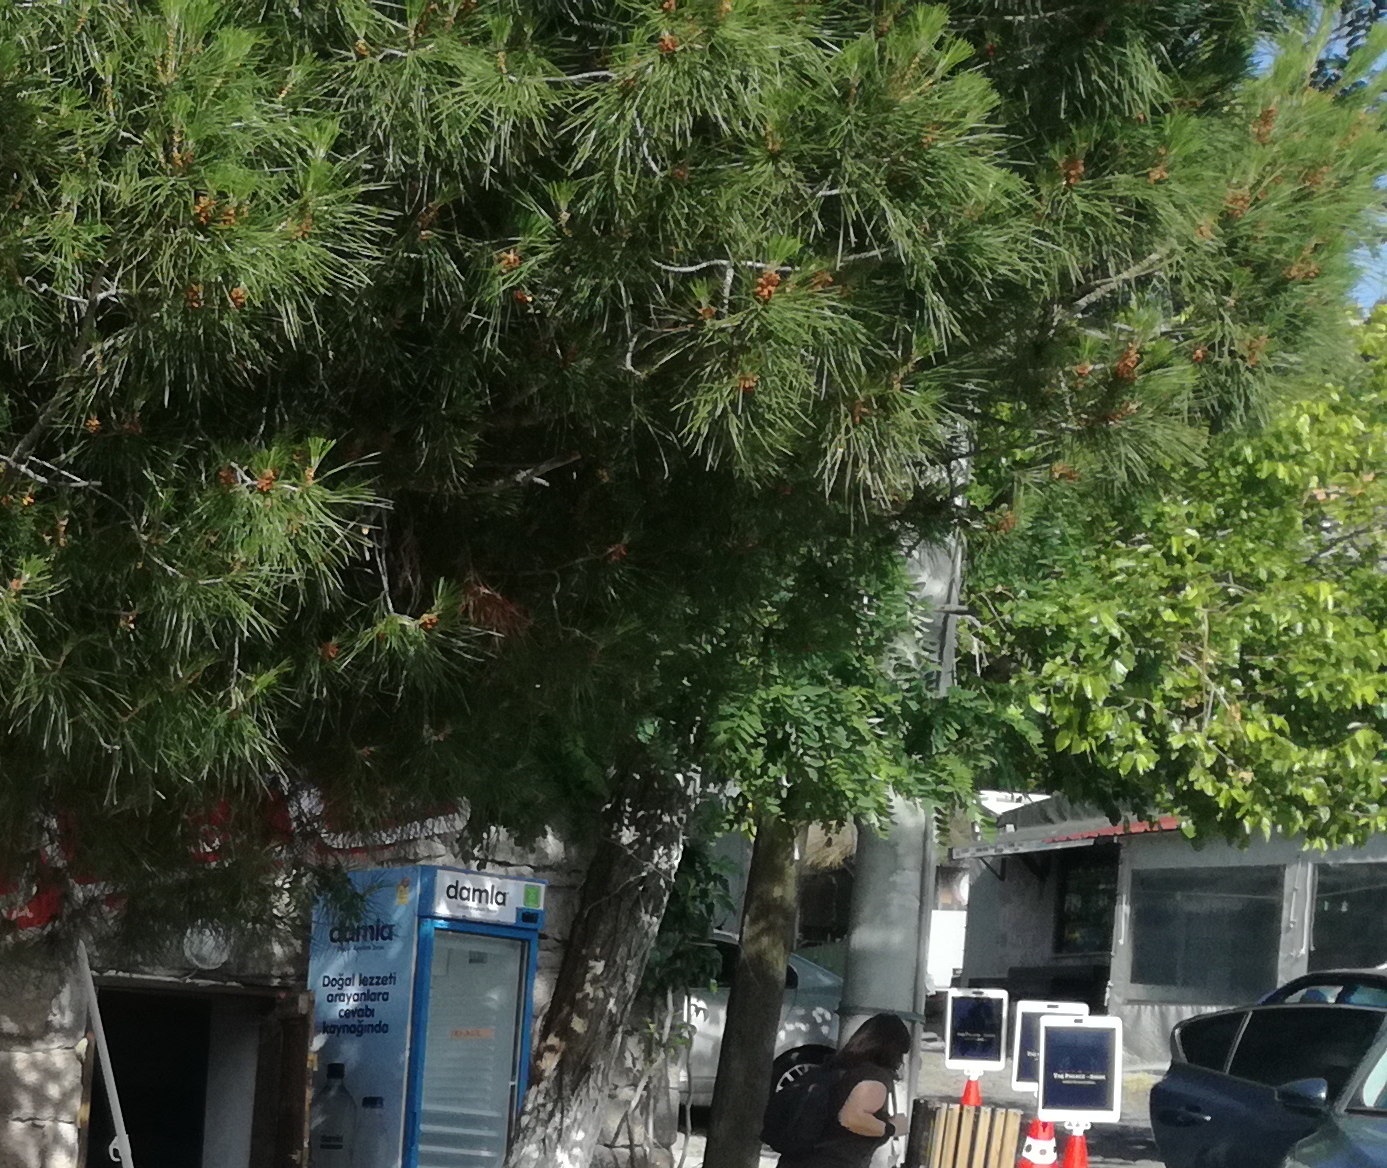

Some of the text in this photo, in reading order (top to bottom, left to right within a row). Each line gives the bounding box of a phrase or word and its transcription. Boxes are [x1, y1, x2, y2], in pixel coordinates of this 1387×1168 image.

[446, 880, 506, 906] damla
[322, 972, 397, 990] Doğal lezzeti
[327, 989, 389, 1005] arayanlara
